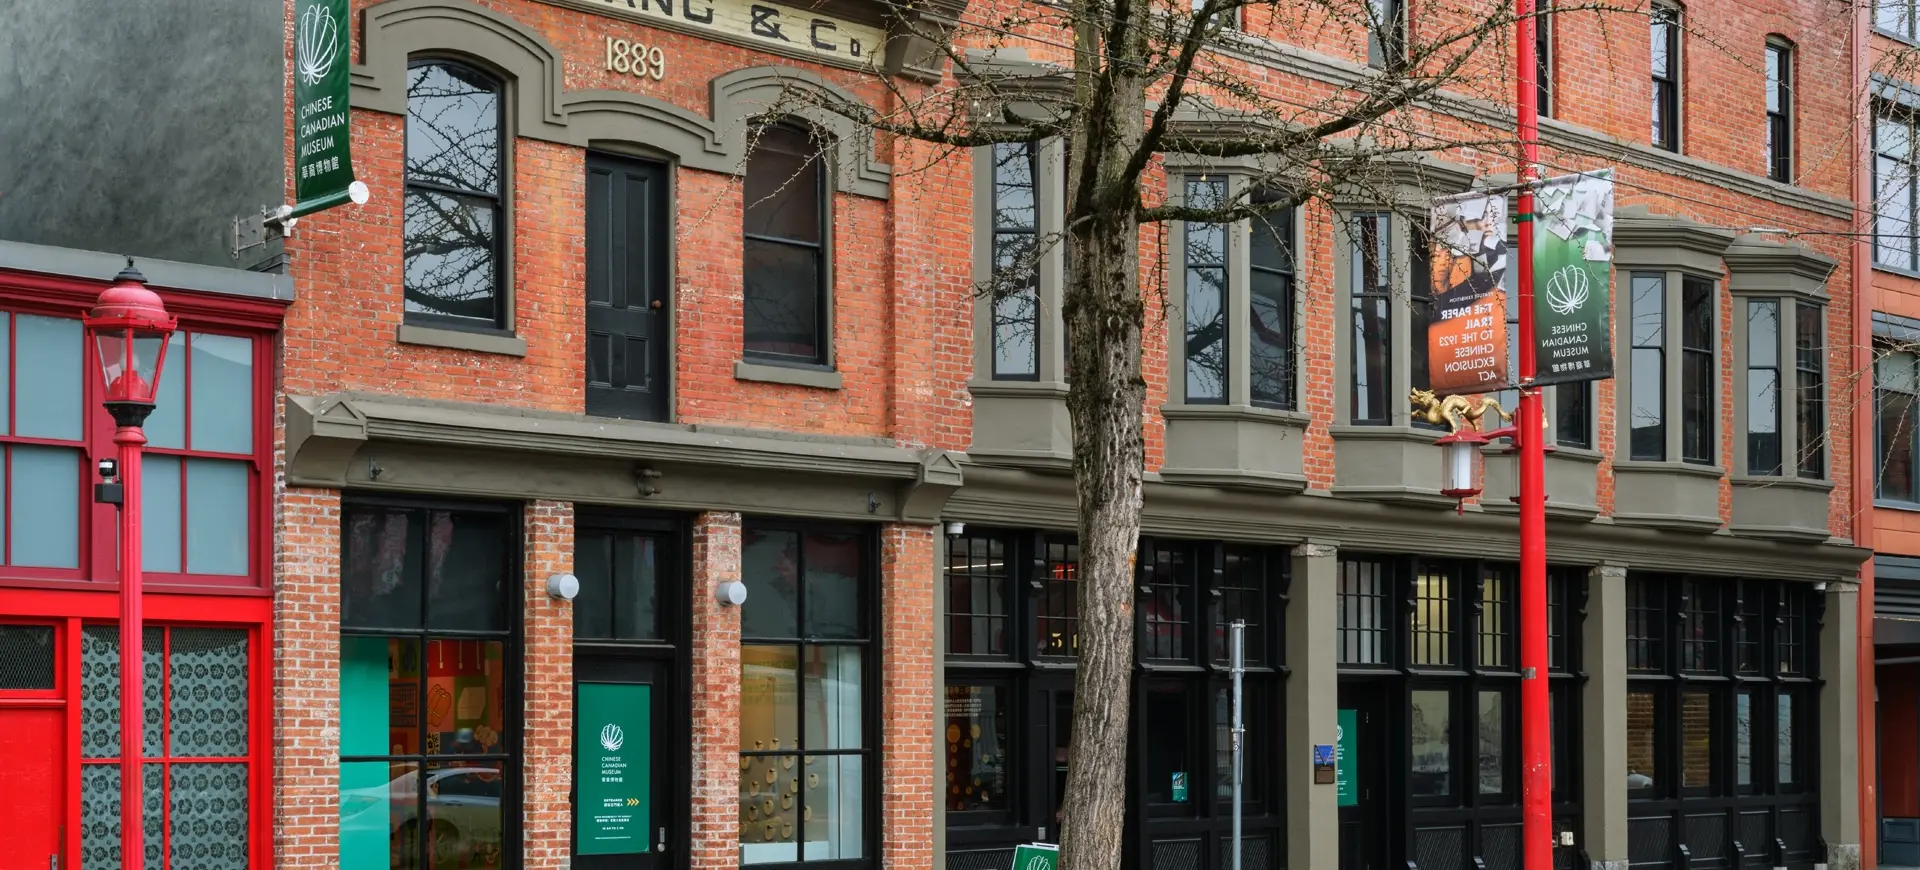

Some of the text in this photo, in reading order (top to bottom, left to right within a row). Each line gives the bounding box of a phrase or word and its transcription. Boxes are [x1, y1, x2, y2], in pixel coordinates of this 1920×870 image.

[605, 0, 713, 24] NG
[751, 4, 790, 42] &
[606, 36, 665, 80] 1889
[301, 96, 332, 119] CHINESE
[301, 112, 345, 138] CANADIAN
[301, 135, 334, 158] MUSEUM
